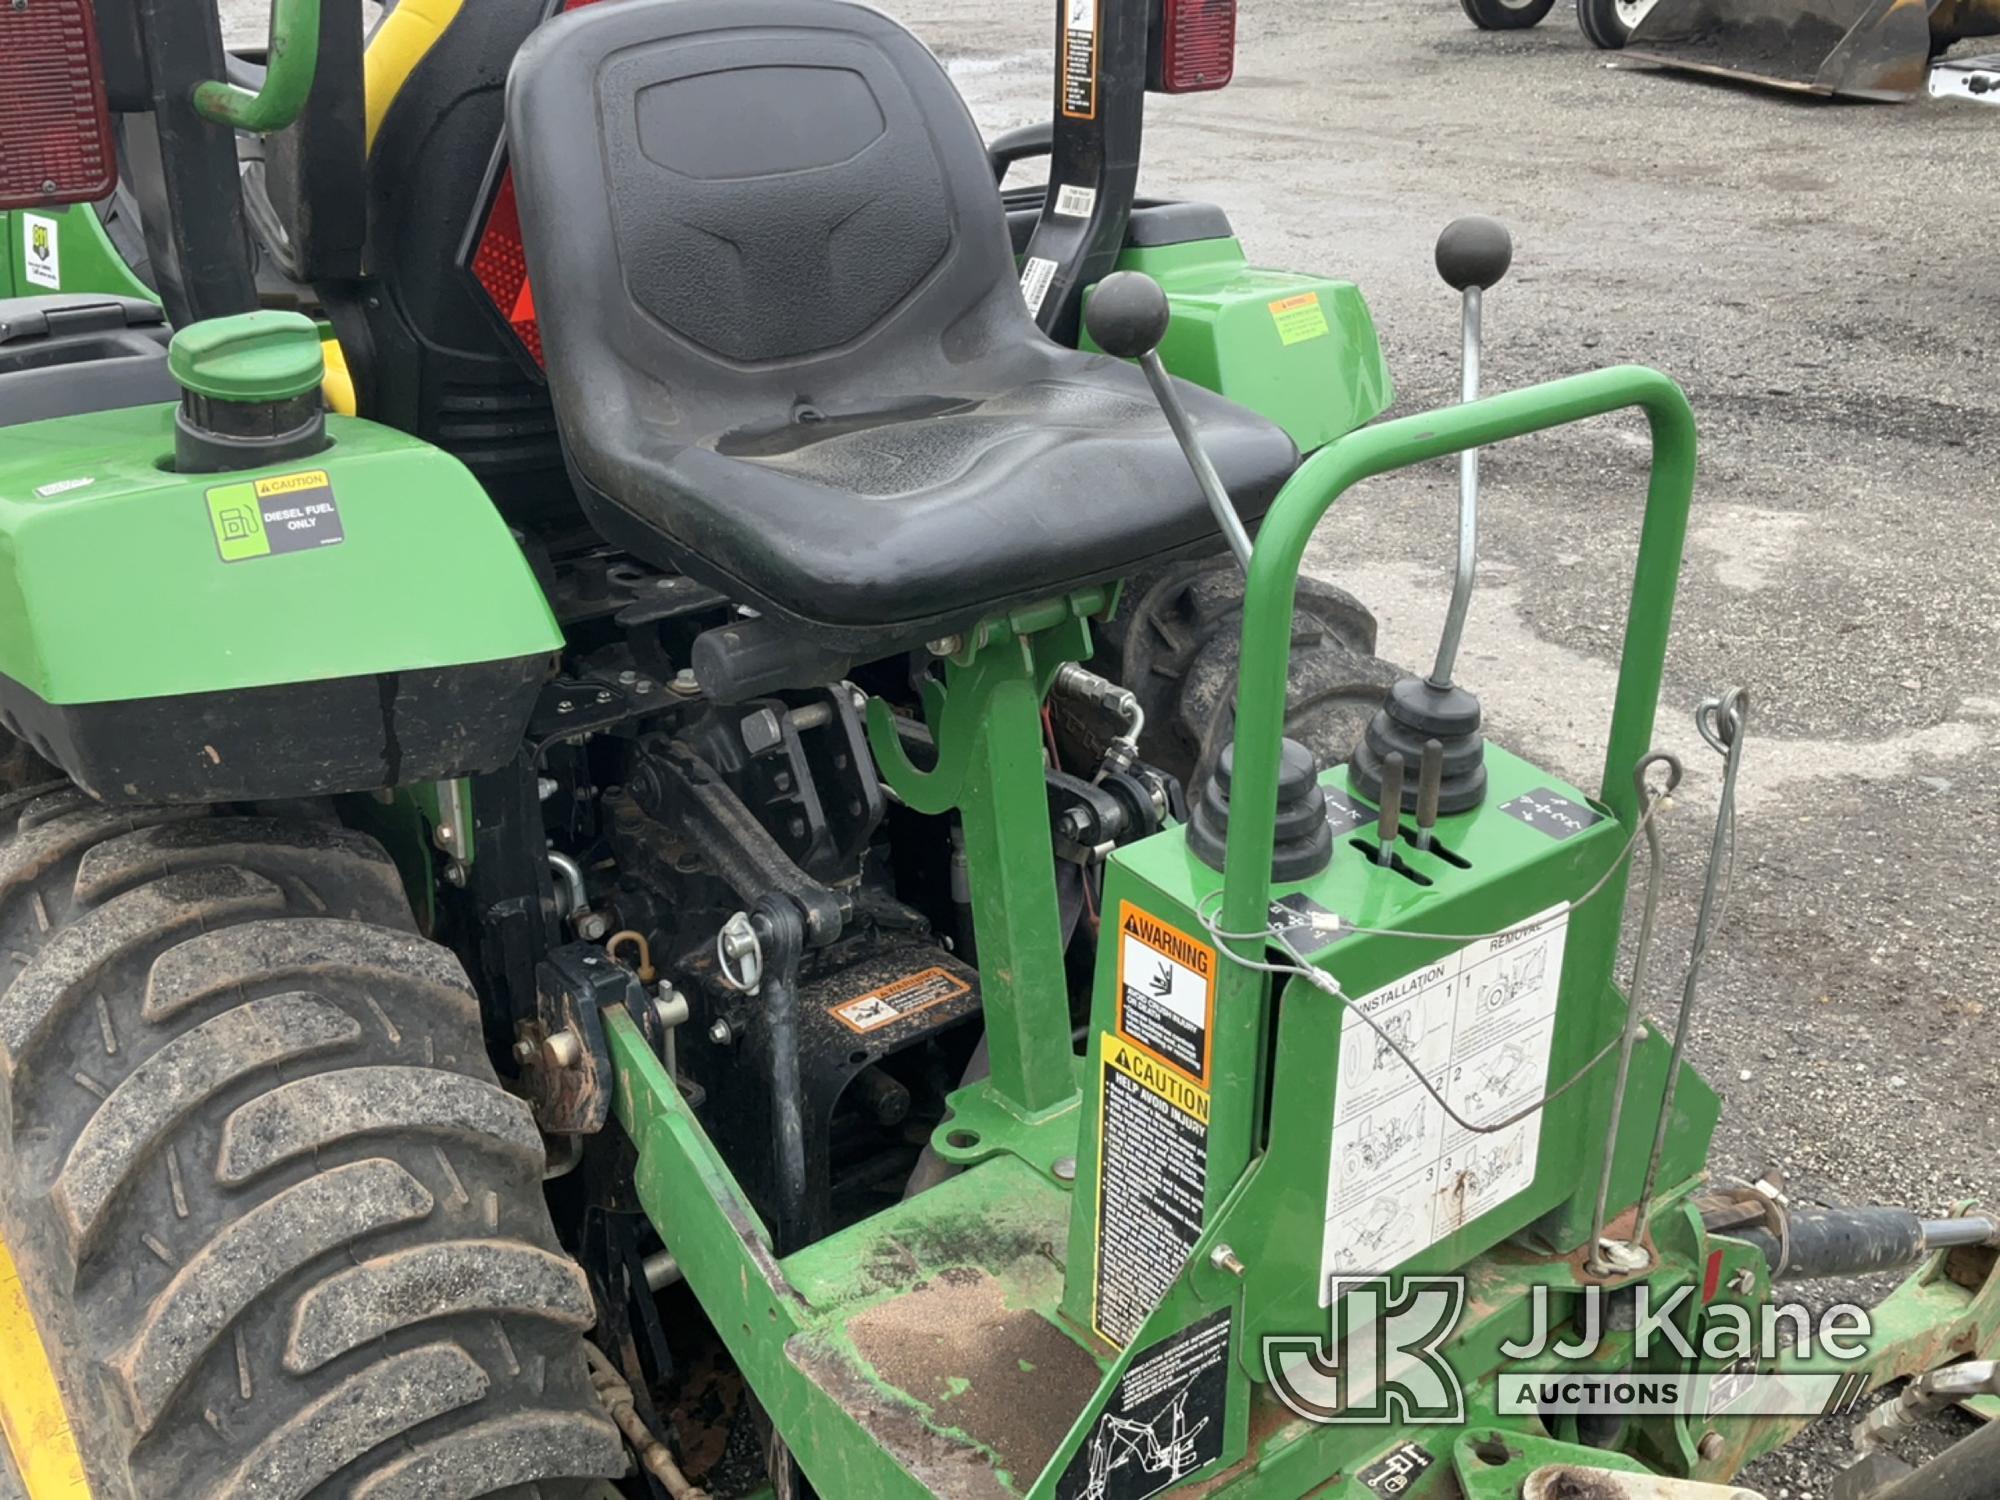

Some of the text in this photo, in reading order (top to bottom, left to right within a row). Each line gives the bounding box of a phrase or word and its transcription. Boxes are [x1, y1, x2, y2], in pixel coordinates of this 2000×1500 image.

[271, 474, 322, 491] CAUTION
[264, 502, 335, 522] DIESEL FUEL
[228, 522, 240, 534] D
[287, 518, 317, 531] ONLY
[1139, 917, 1208, 974] WARNING
[1465, 974, 1471, 988] 1
[1446, 983, 1452, 998] 1
[1454, 1066, 1462, 1082] 2
[1132, 1055, 1208, 1119] CAUTION
[1435, 1076, 1443, 1091] 2
[1115, 1071, 1206, 1138] HELP AVOID INJURY
[1444, 1156, 1452, 1172] 3
[1425, 1167, 1434, 1182] 3
